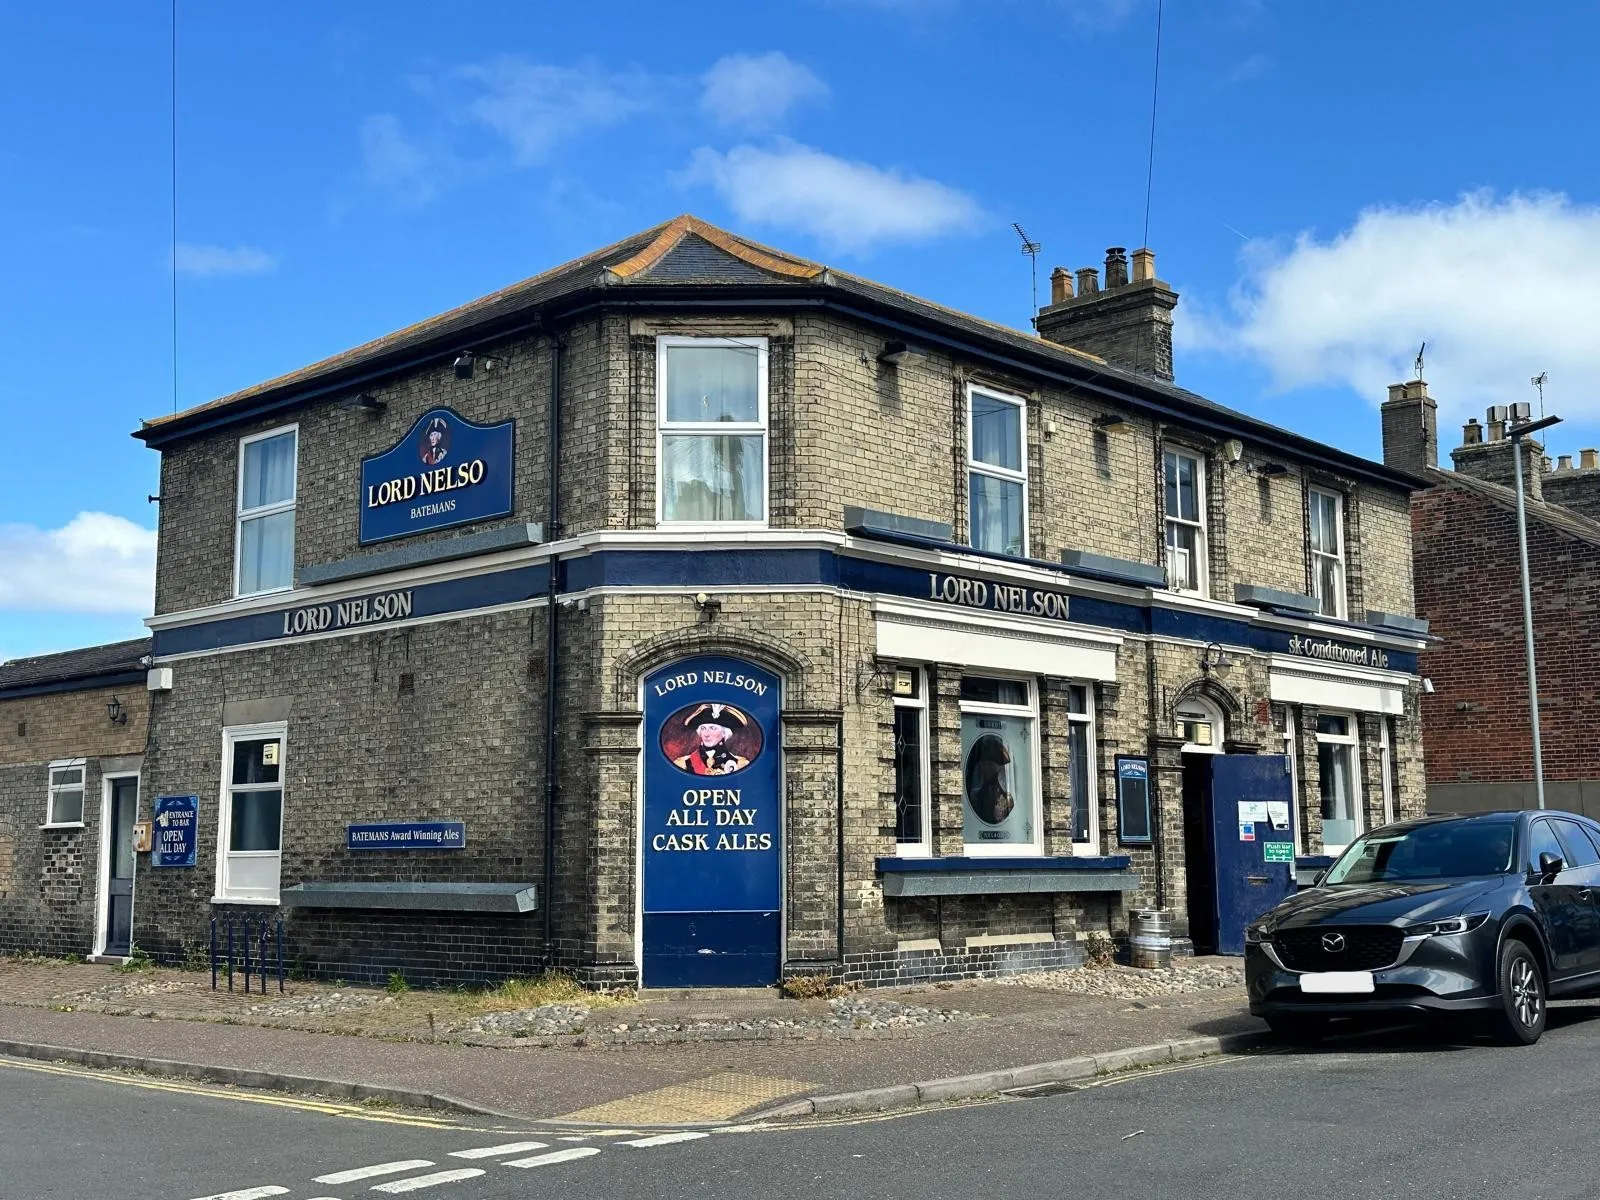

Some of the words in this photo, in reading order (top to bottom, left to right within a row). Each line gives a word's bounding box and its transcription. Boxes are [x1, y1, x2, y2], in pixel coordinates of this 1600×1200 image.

[367, 475, 416, 508] LORD
[419, 459, 484, 496] NELSO
[410, 499, 456, 519] BATEMANS
[928, 573, 988, 607] LORD
[992, 583, 1070, 619] NELSON
[282, 606, 332, 635] LORD
[336, 590, 412, 627] NELSON
[1370, 649, 1389, 668] Ale
[654, 672, 698, 697] LORD
[703, 671, 768, 697] NELSON
[682, 788, 741, 806] OPEN
[169, 810, 194, 819] ENTRANCE
[172, 819, 178, 827] TO
[179, 819, 190, 827] BAR
[666, 809, 708, 826] ALL
[715, 809, 757, 826] DAY
[163, 830, 184, 842] OPEN
[351, 831, 389, 841] BATEMANS
[390, 829, 412, 841] Award
[413, 829, 442, 843] Winning
[443, 829, 460, 840] Ales
[652, 833, 710, 851] CASK
[716, 833, 772, 851] ALES
[160, 843, 173, 853] ALL
[173, 843, 187, 853] DAY
